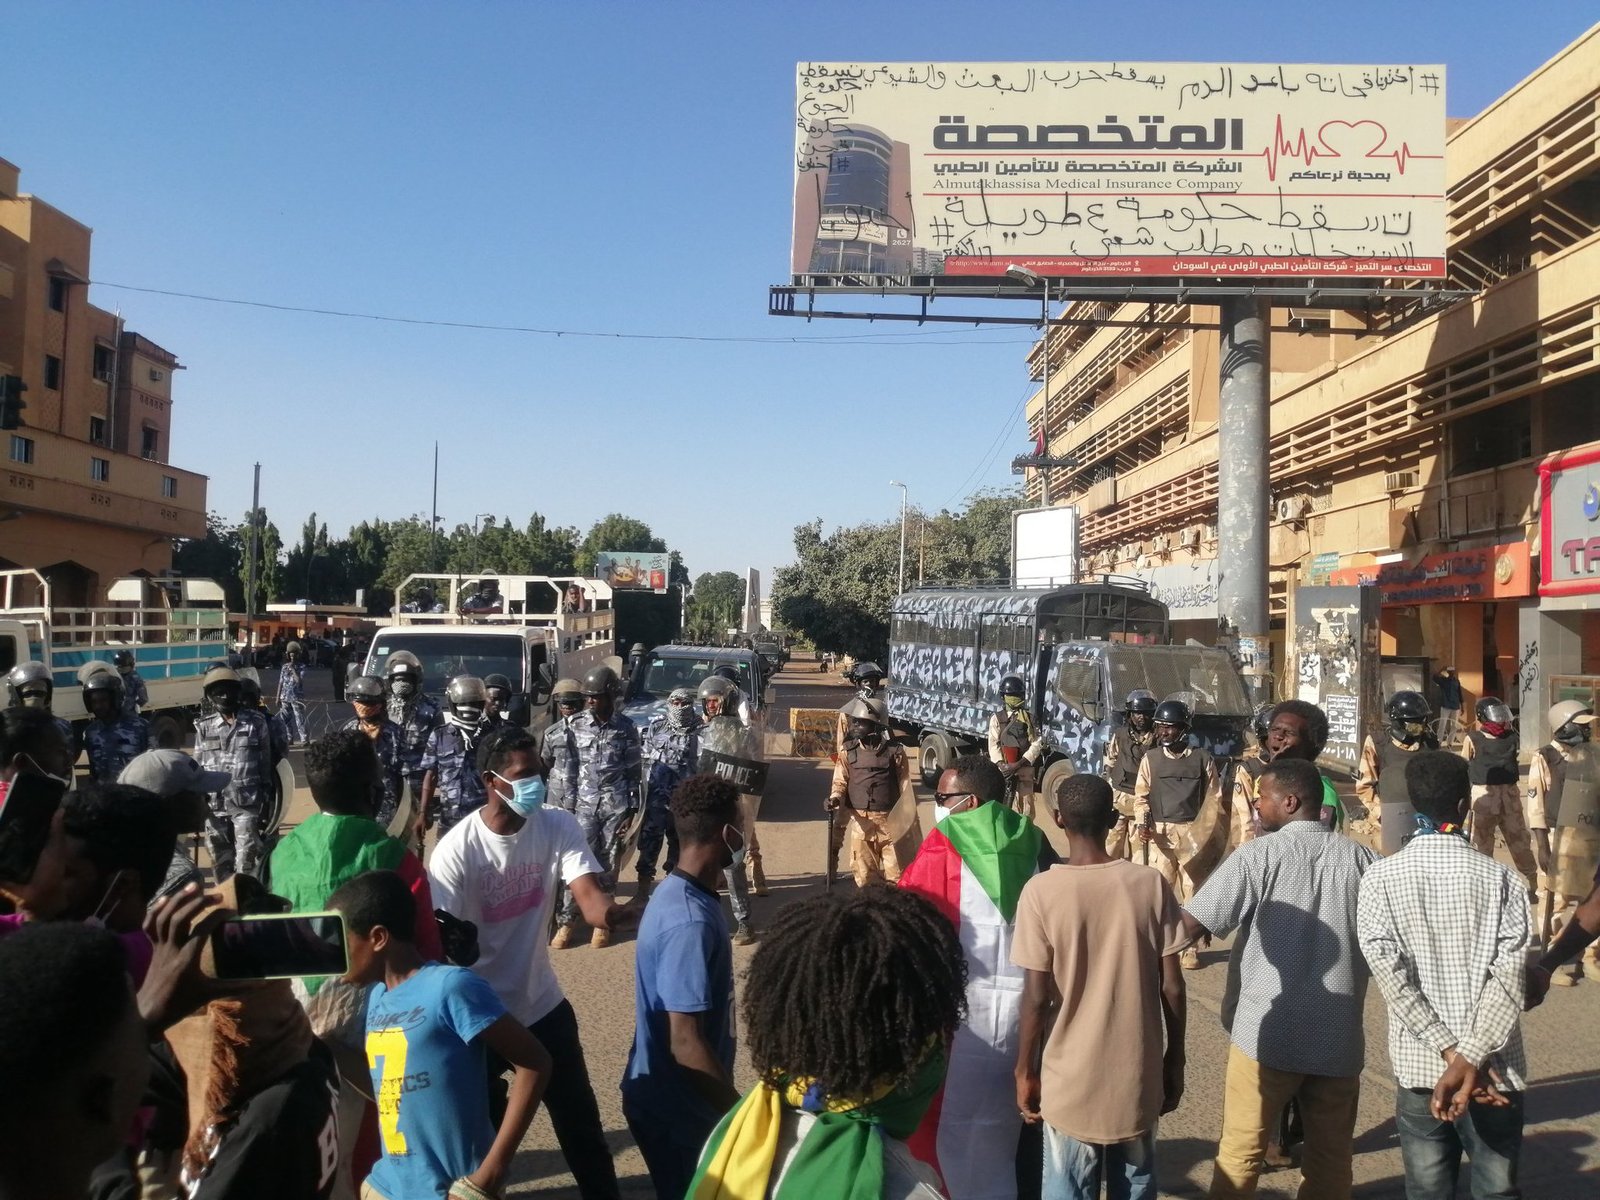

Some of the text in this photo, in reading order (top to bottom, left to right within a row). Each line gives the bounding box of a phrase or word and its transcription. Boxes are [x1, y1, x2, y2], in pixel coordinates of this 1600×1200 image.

[1042, 69, 1107, 89] حزب
[1178, 66, 1232, 110] الدم
[798, 92, 854, 121] الجوع
[933, 115, 1244, 150] المتخصصة
[933, 157, 1243, 176] الشركة المتخصصة للتأمين الطبي
[1289, 170, 1391, 182] بمحبة نرعاكم
[933, 178, 1243, 191] Almutakhassisa Medical Insurance Company
[1172, 261, 1209, 272] السودان
[1210, 262, 1227, 273] في
[1228, 260, 1258, 272] الأولى
[1259, 261, 1289, 273] الطبي
[1290, 258, 1321, 272] التأمين
[1323, 261, 1348, 272] شركة
[1355, 262, 1379, 272] التميز
[1380, 264, 1393, 272] سر
[715, 761, 753, 786] POLICE
